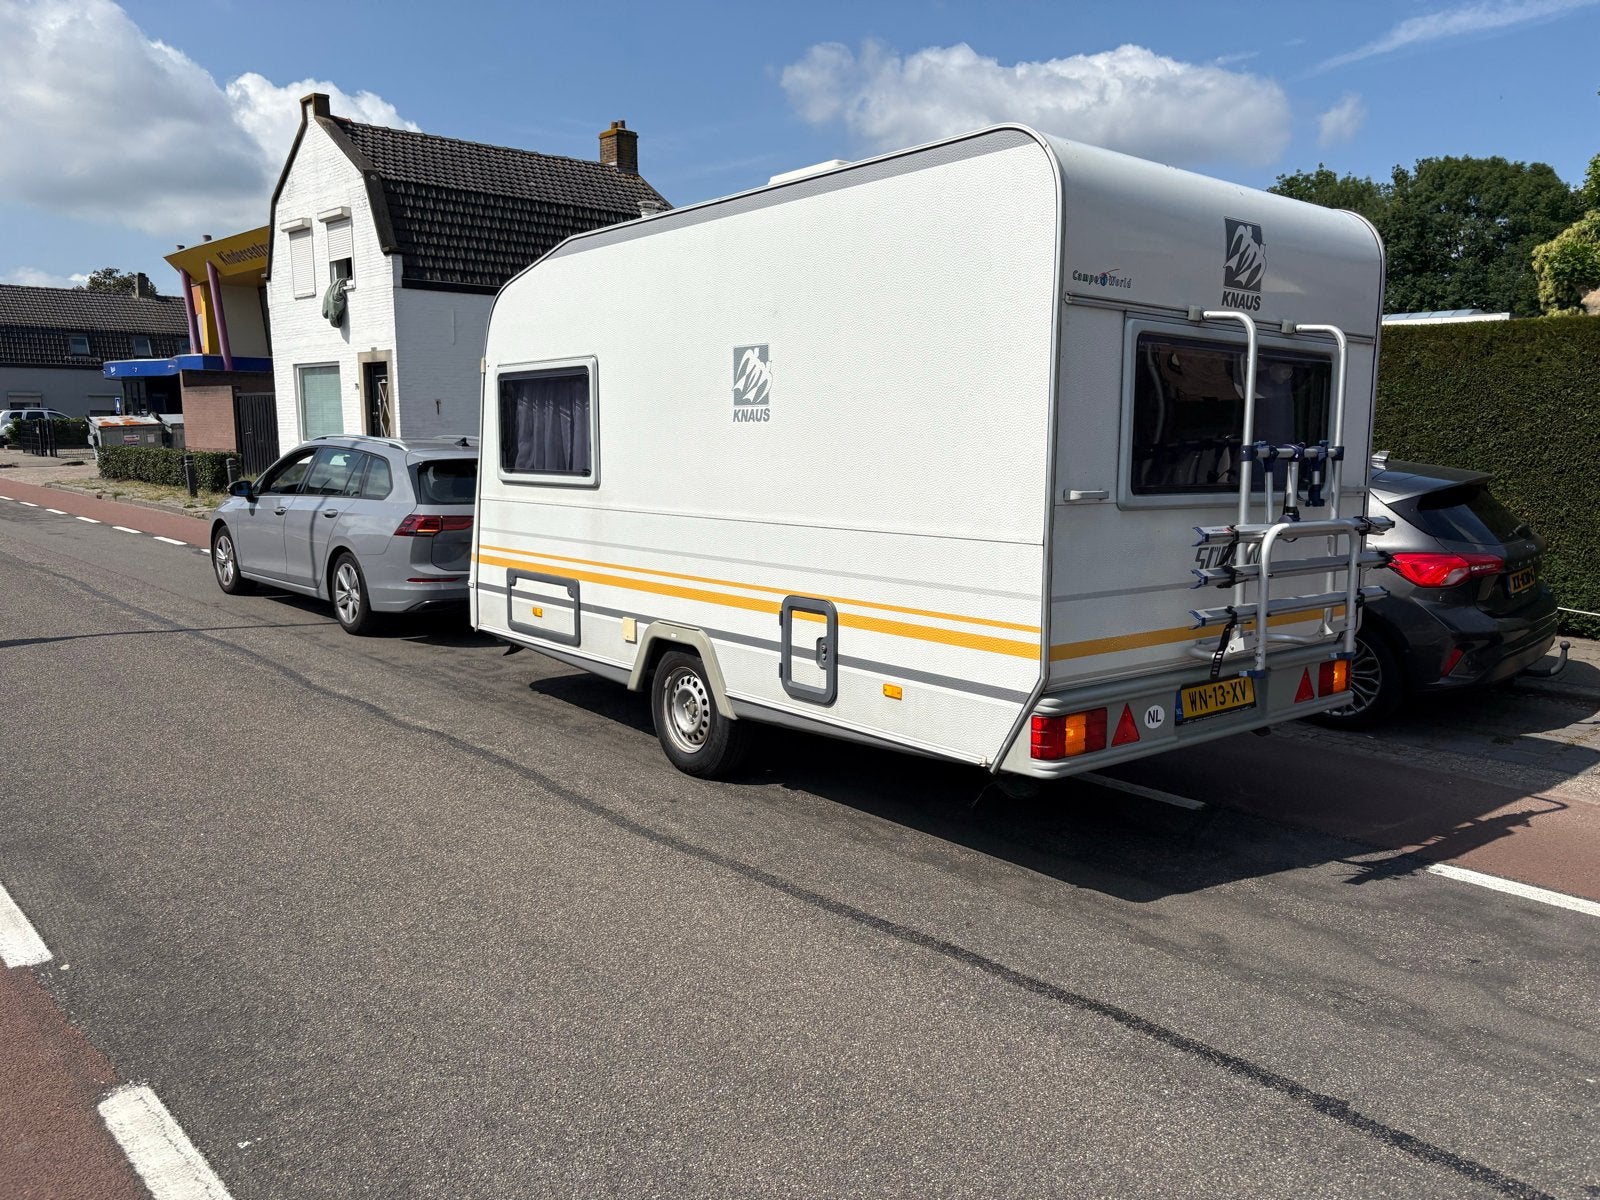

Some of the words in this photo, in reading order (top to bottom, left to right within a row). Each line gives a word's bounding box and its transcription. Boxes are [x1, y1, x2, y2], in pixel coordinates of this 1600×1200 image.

[1221, 290, 1262, 312] KNAUS
[732, 408, 771, 423] KNAUS
[1188, 679, 1246, 713] WN-13-XV
[1147, 709, 1162, 724] NL
